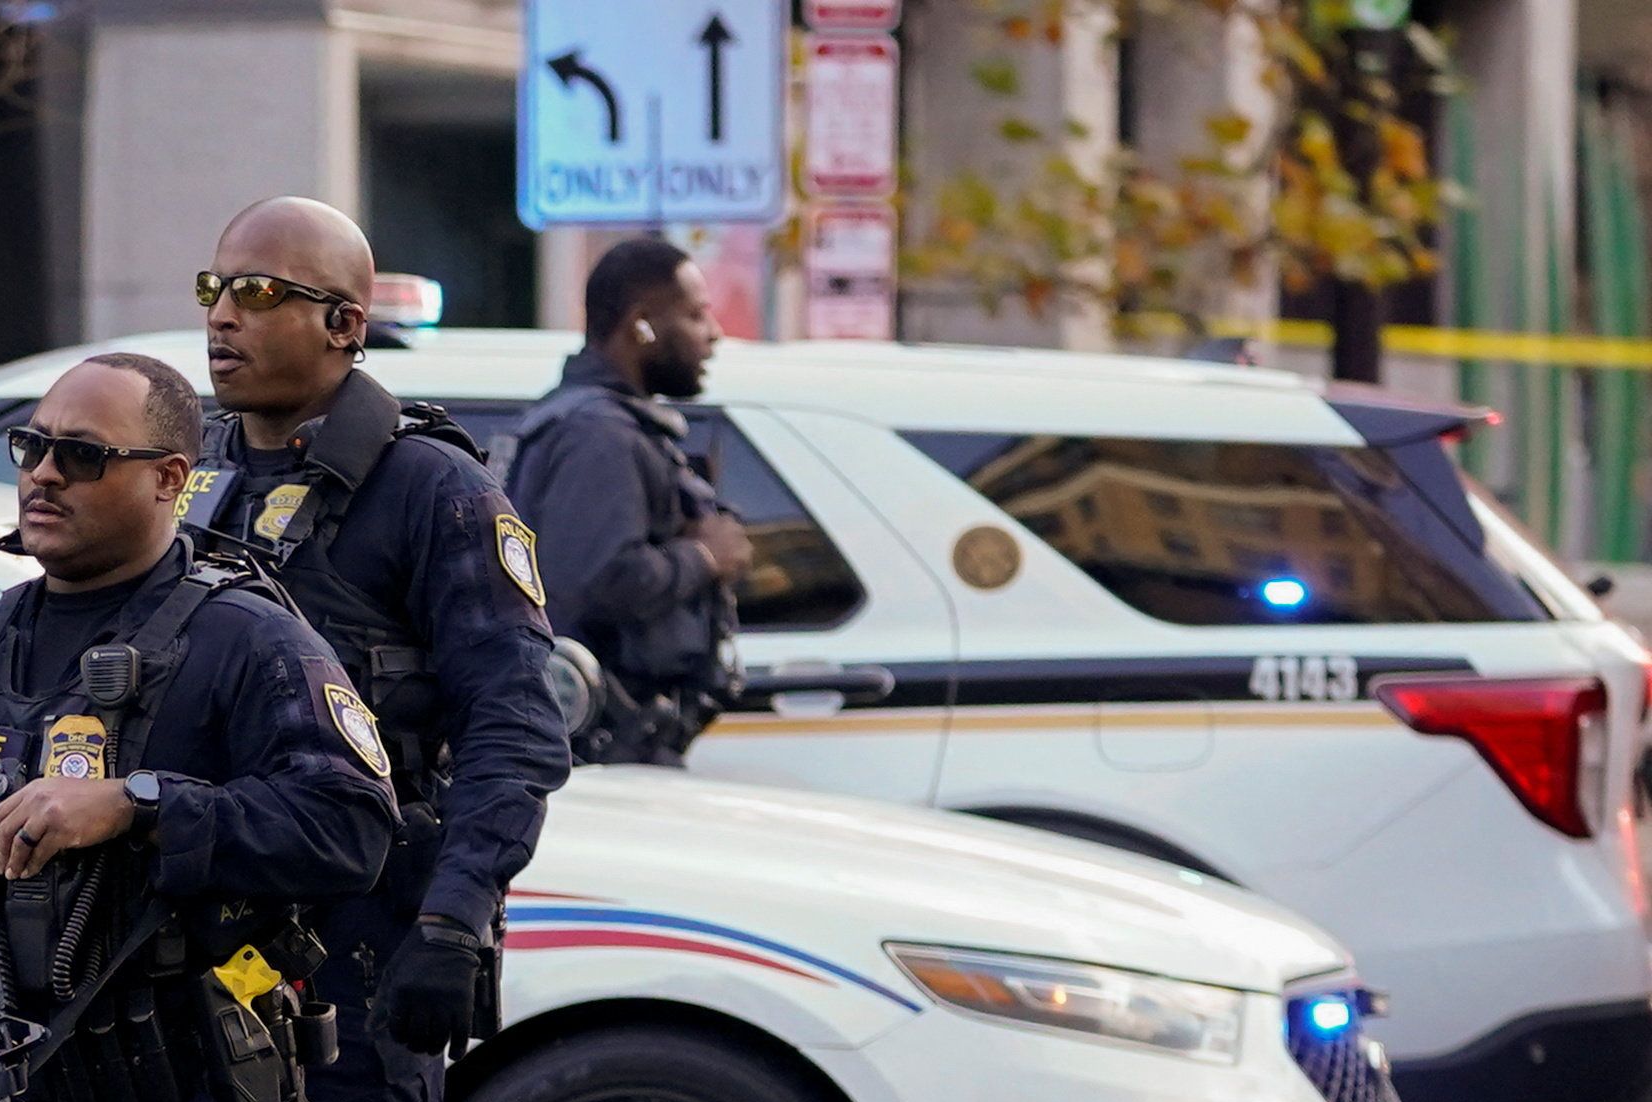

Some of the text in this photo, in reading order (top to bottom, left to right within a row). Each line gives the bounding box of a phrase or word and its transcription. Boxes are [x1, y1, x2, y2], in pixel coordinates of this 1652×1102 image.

[538, 163, 649, 201] ONLY
[657, 163, 768, 201] ONLY
[182, 470, 219, 493] ICE
[500, 521, 531, 549] POLICE
[1249, 655, 1358, 700] 4143
[330, 691, 374, 726] POLICE
